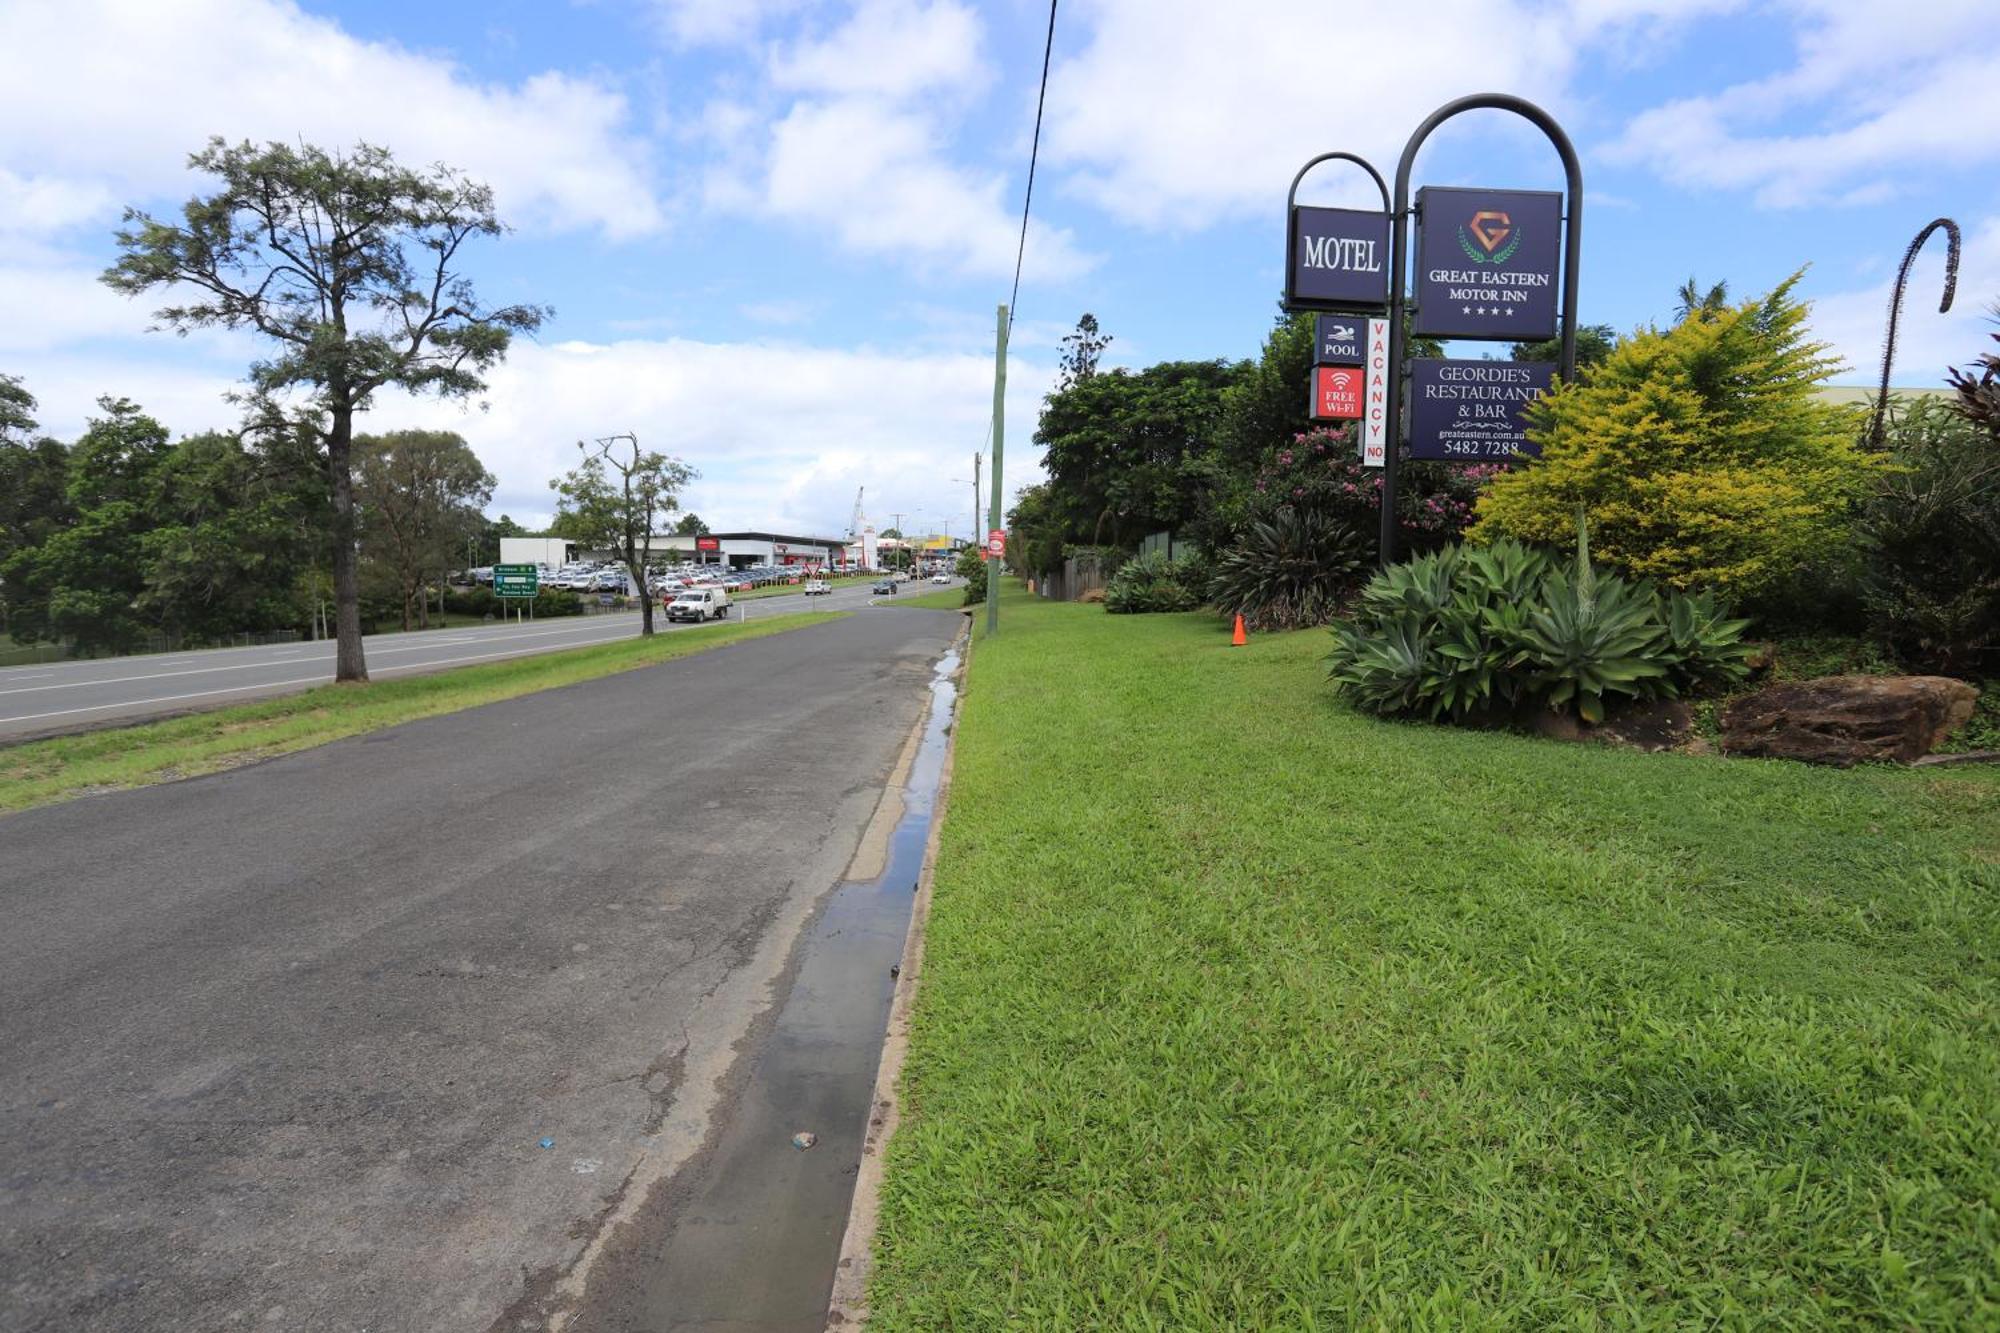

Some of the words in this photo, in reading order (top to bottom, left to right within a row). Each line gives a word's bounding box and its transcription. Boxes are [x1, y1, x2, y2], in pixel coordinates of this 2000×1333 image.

[1303, 235, 1381, 273] MOTEL
[1429, 269, 1478, 283] GREAT
[1482, 271, 1550, 286] EASTERN
[1449, 288, 1499, 301] MOTOR
[1502, 290, 1528, 302] INN
[1324, 344, 1359, 357] POOL
[1371, 322, 1384, 438] VACANCY
[1439, 366, 1531, 383] GEORDIE'S
[1325, 391, 1356, 402] FREE
[1425, 384, 1542, 401] RESTAURANT
[1326, 402, 1355, 413] Wi-Fi
[1458, 404, 1471, 417] &
[1475, 403, 1507, 418] BAR
[1439, 430, 1525, 440] greateastern.com.au
[1367, 447, 1383, 458] NO
[1444, 440, 1479, 454] 5482
[1485, 442, 1519, 455] 7288
